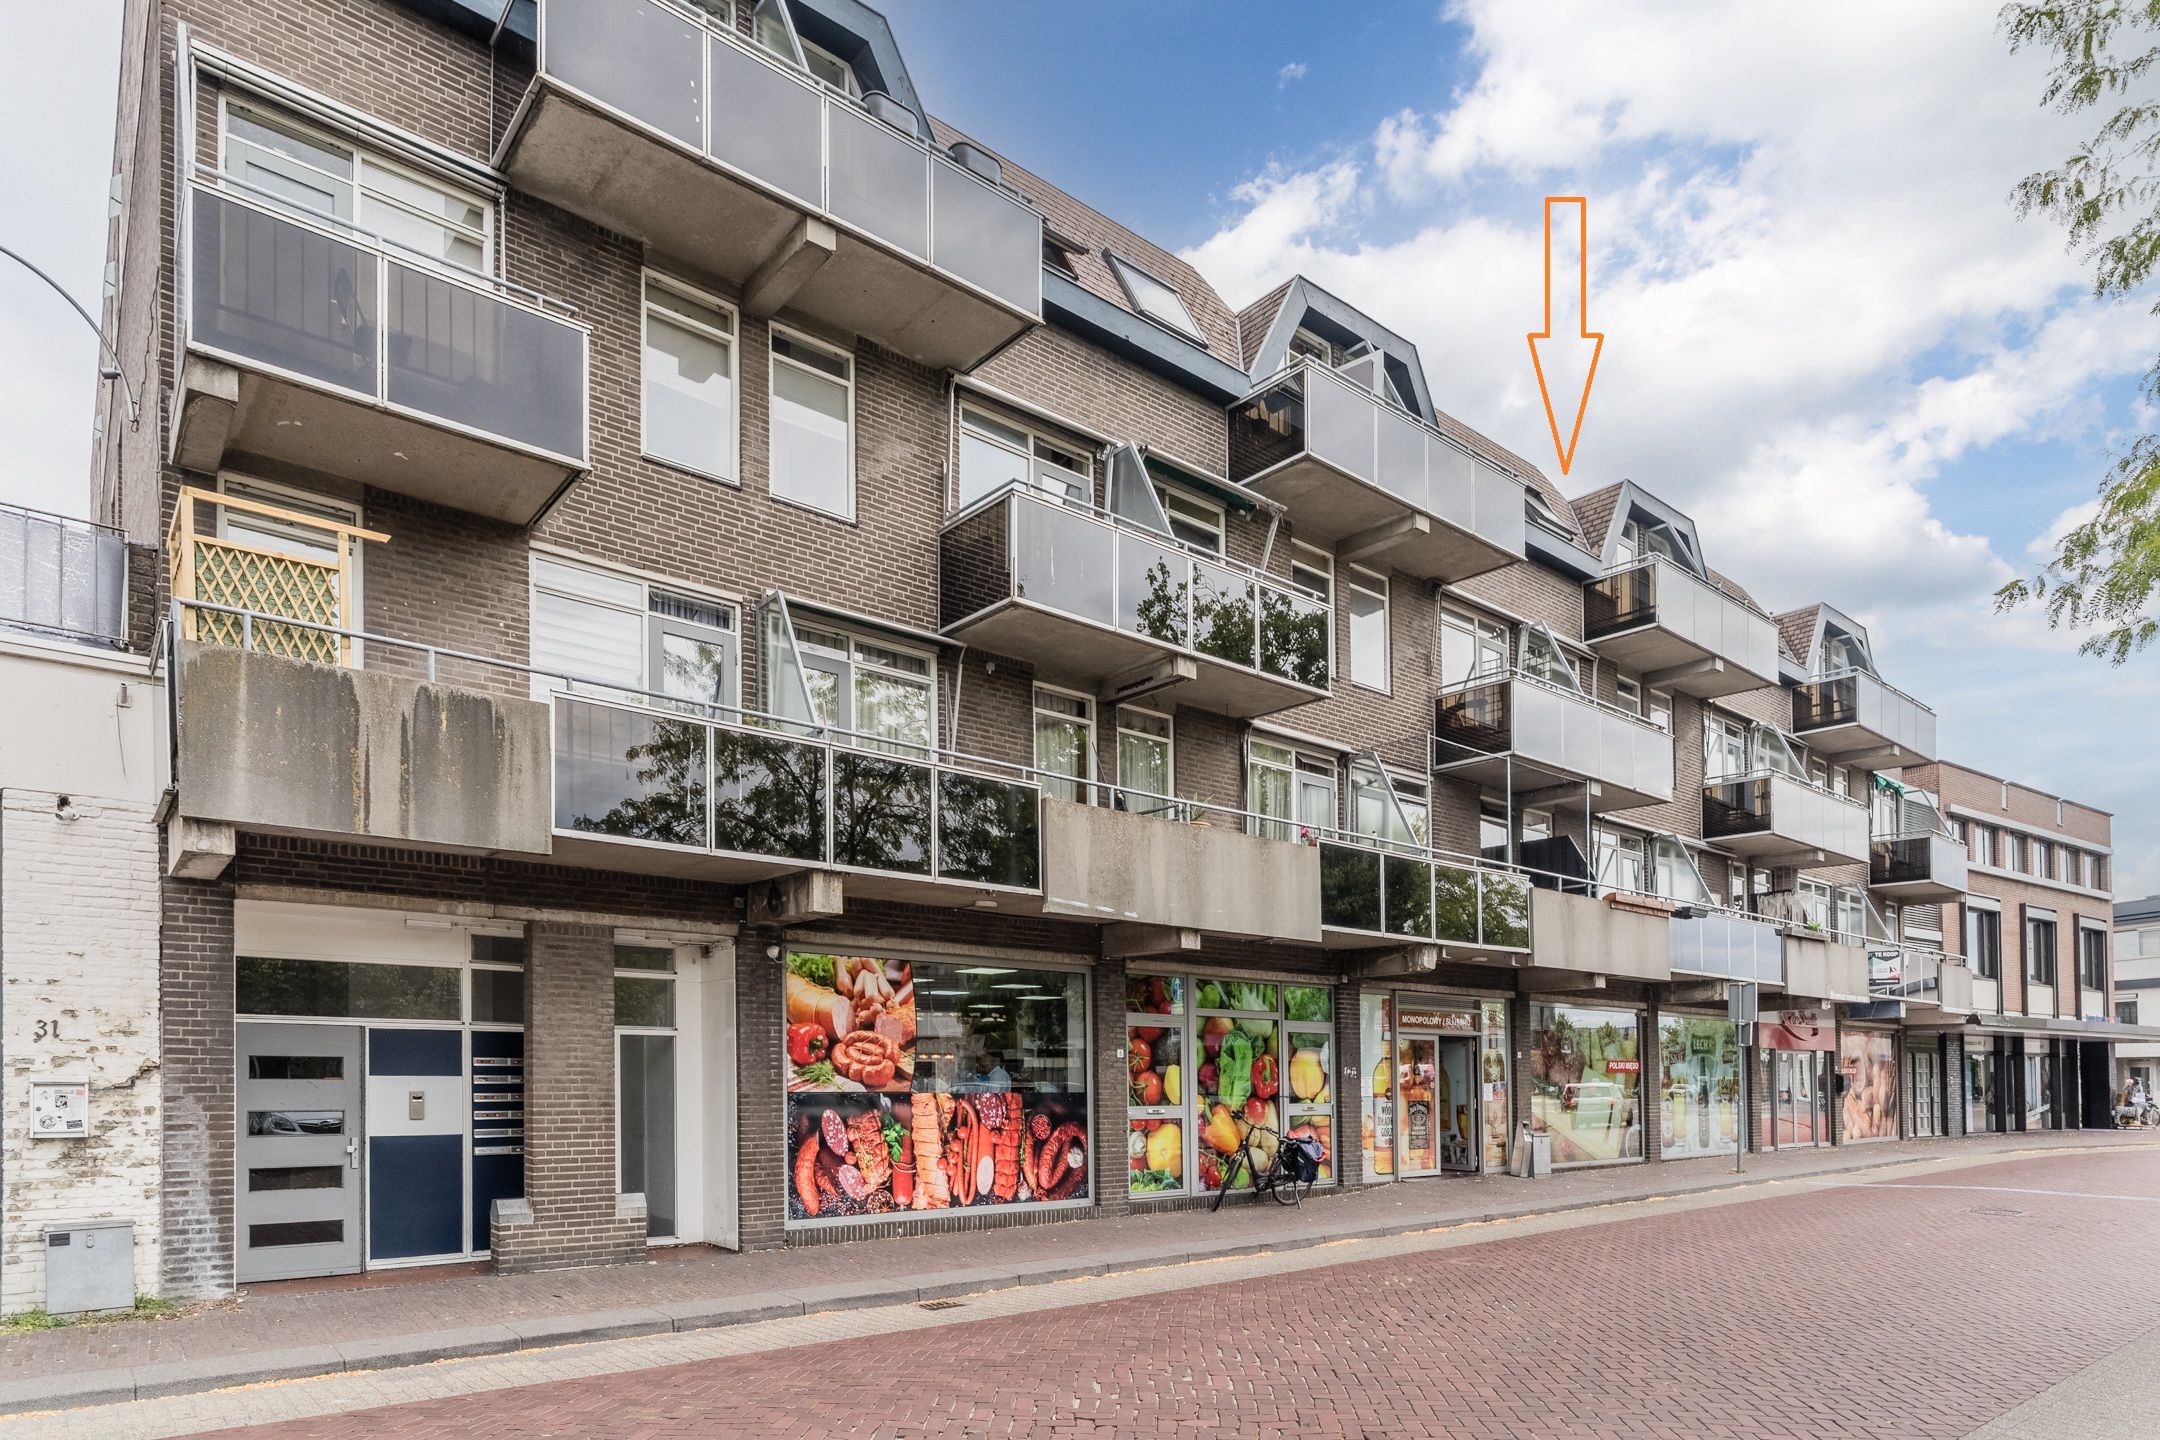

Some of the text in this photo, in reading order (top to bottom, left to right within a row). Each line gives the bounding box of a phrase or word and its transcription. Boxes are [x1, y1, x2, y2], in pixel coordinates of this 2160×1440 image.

[1402, 1015, 1441, 1025] MONOPOLOWY
[33, 1019, 60, 1043] 31
[1693, 1039, 1709, 1050] LECH
[1609, 1061, 1626, 1070] POLSKI
